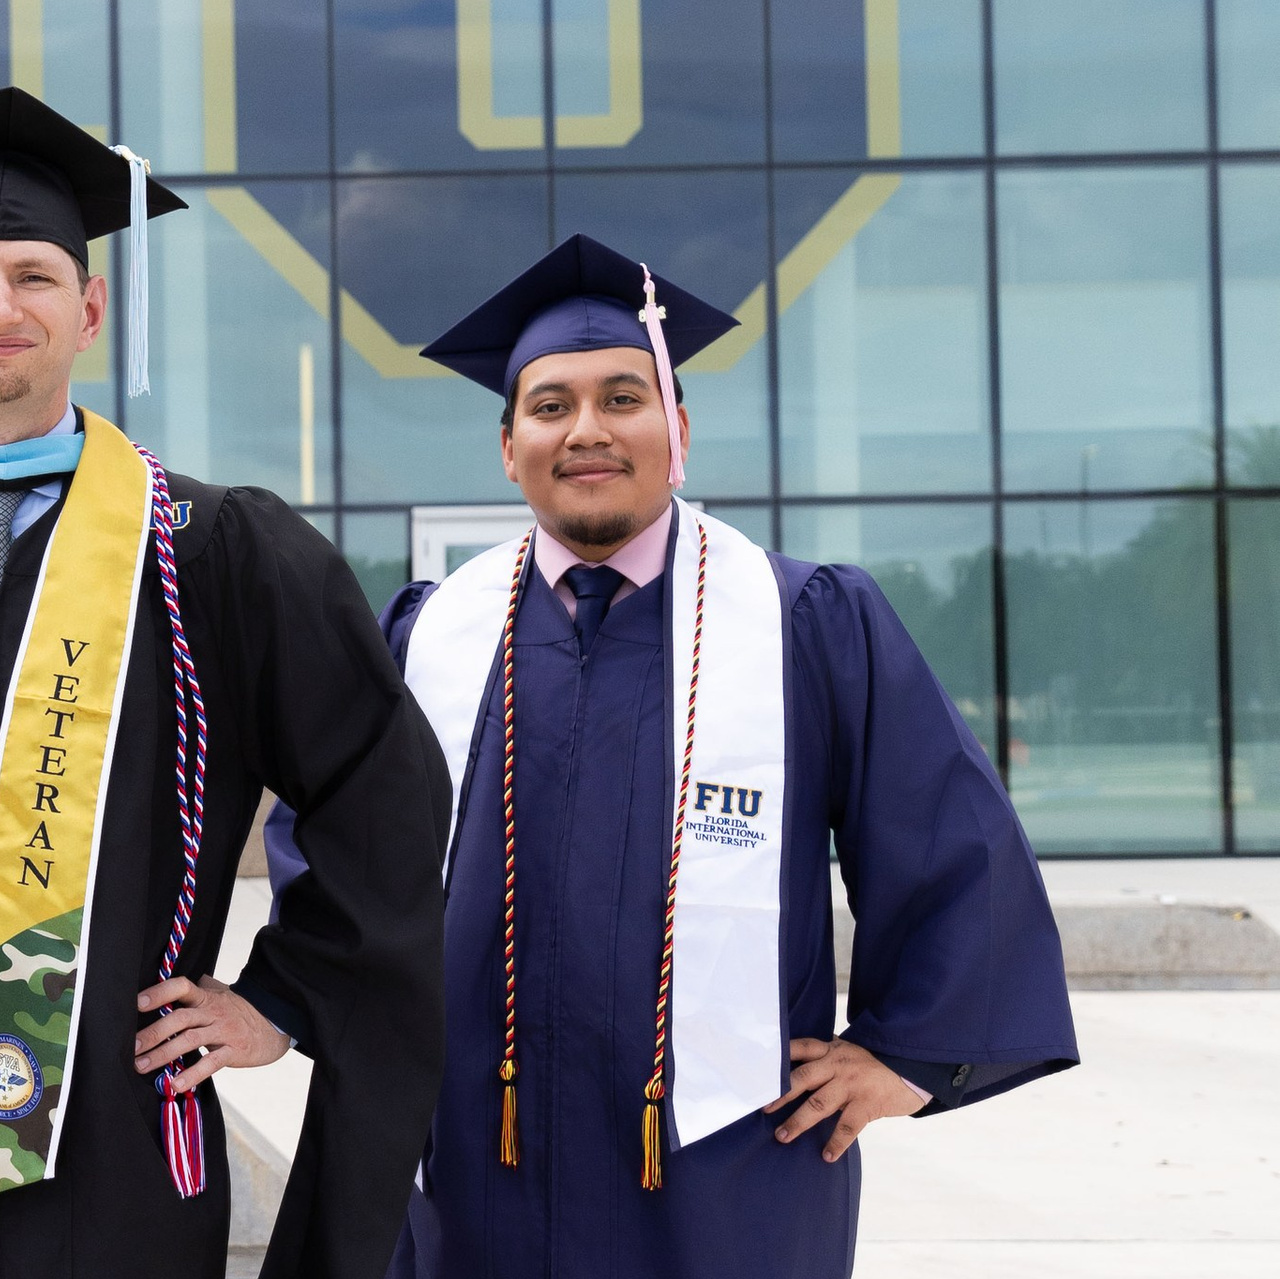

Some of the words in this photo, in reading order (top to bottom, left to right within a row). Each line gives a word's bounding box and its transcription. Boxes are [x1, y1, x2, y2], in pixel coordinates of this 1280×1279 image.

[17, 638, 89, 889] VETERAN
[693, 781, 764, 819] FIU
[685, 822, 767, 841] INTERNATIONAL
[705, 815, 748, 829] FLORIDA
[695, 833, 757, 849] UNIVERSITY
